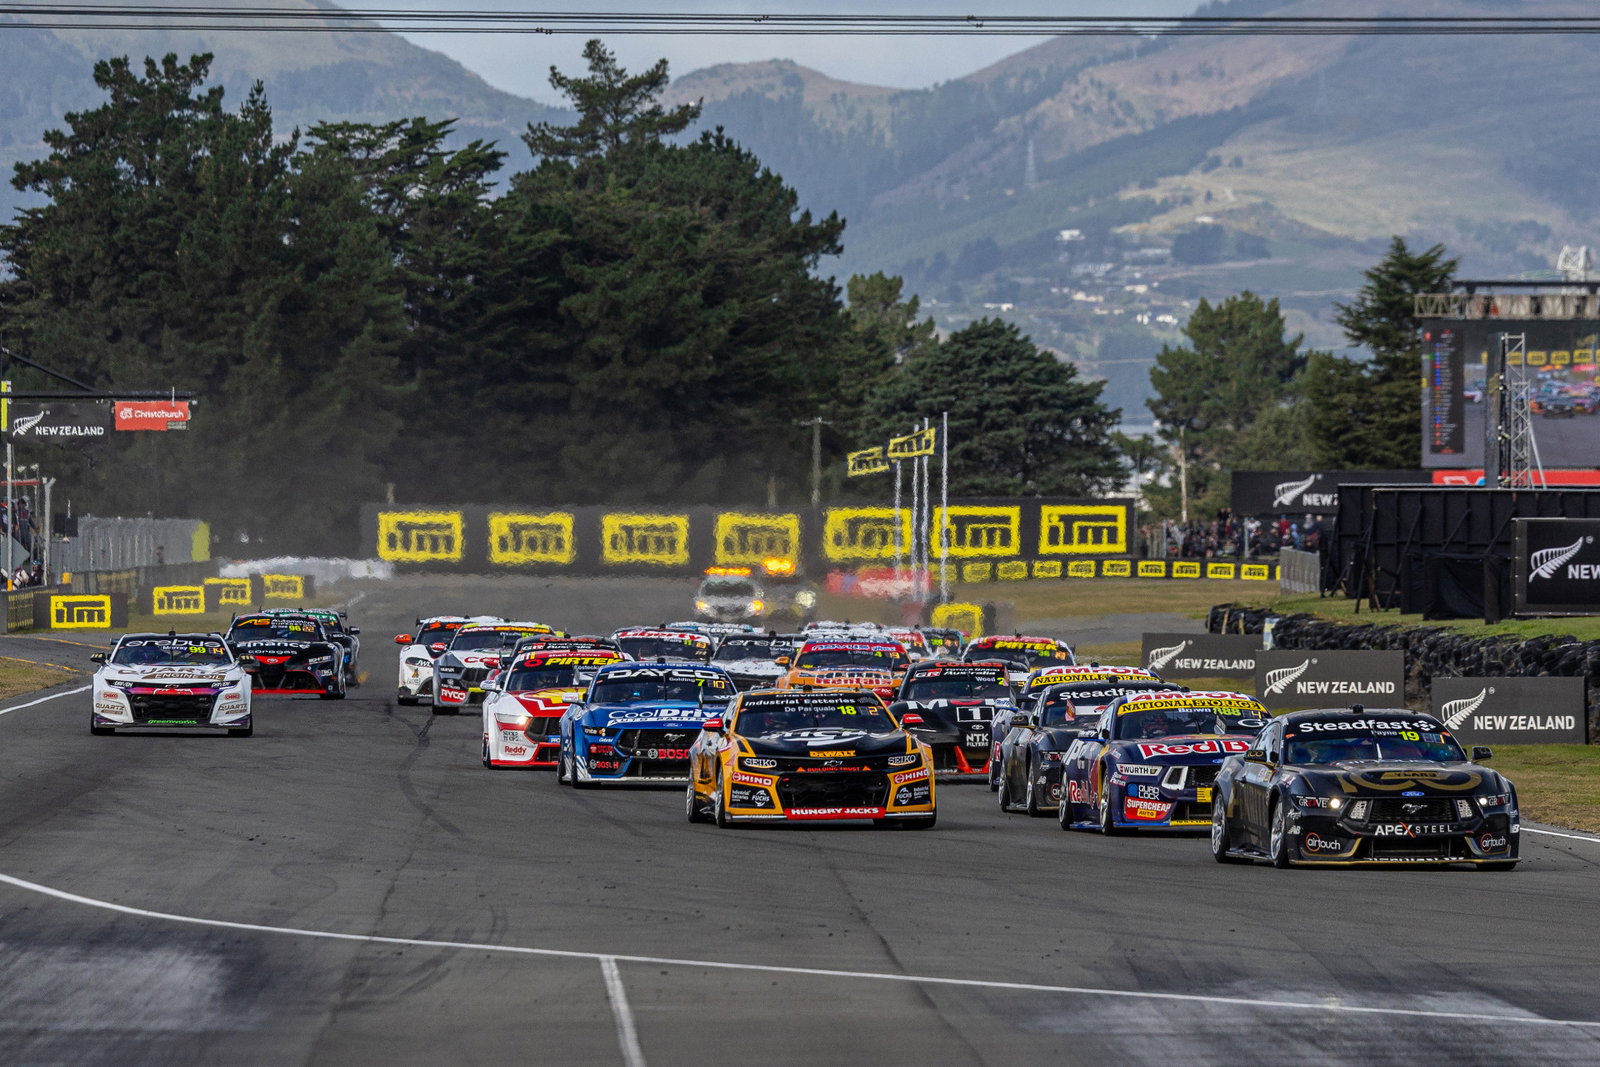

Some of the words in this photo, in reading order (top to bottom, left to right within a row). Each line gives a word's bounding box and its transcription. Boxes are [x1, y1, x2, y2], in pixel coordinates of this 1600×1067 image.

[134, 410, 184, 419] Christchurch
[35, 426, 57, 436] NEW
[59, 426, 104, 436] ZEALAND
[1302, 493, 1333, 507] NEW
[189, 646, 206, 654] 99
[545, 657, 624, 666] PIRTEK
[1175, 659, 1202, 669] NEW
[1203, 659, 1256, 669] ZEALAND
[607, 668, 719, 680] DAYCO
[1045, 668, 1148, 676] AMPOL
[695, 678, 706, 687] 7
[1035, 675, 1098, 685] NATIONAL
[1296, 681, 1330, 694] NEW
[1331, 681, 1395, 694] ZEALAND
[441, 689, 466, 700] RYCO
[1132, 691, 1248, 702] AMPOL
[745, 699, 800, 707] Industrial
[1122, 699, 1190, 712] NATIONAL
[837, 705, 857, 715] 18
[1299, 719, 1413, 733] Steadfast
[1473, 715, 1507, 730] NEW
[1509, 715, 1575, 730] ZEALAND
[966, 733, 989, 742] NTK
[1398, 731, 1420, 741] 19
[504, 745, 527, 757] Reddy
[744, 757, 778, 768] SEIKO
[887, 754, 917, 765] SEIKO
[741, 775, 772, 786] HINO
[1138, 784, 1160, 793] QUAD
[1138, 791, 1160, 800] LOCK
[1126, 799, 1172, 812] SUPERCHEAP
[1298, 799, 1328, 808] GROVE
[1375, 823, 1414, 837] APEX
[1414, 825, 1453, 834] STEEL
[1307, 837, 1341, 850] airtouch
[1481, 836, 1507, 848] airtouch
